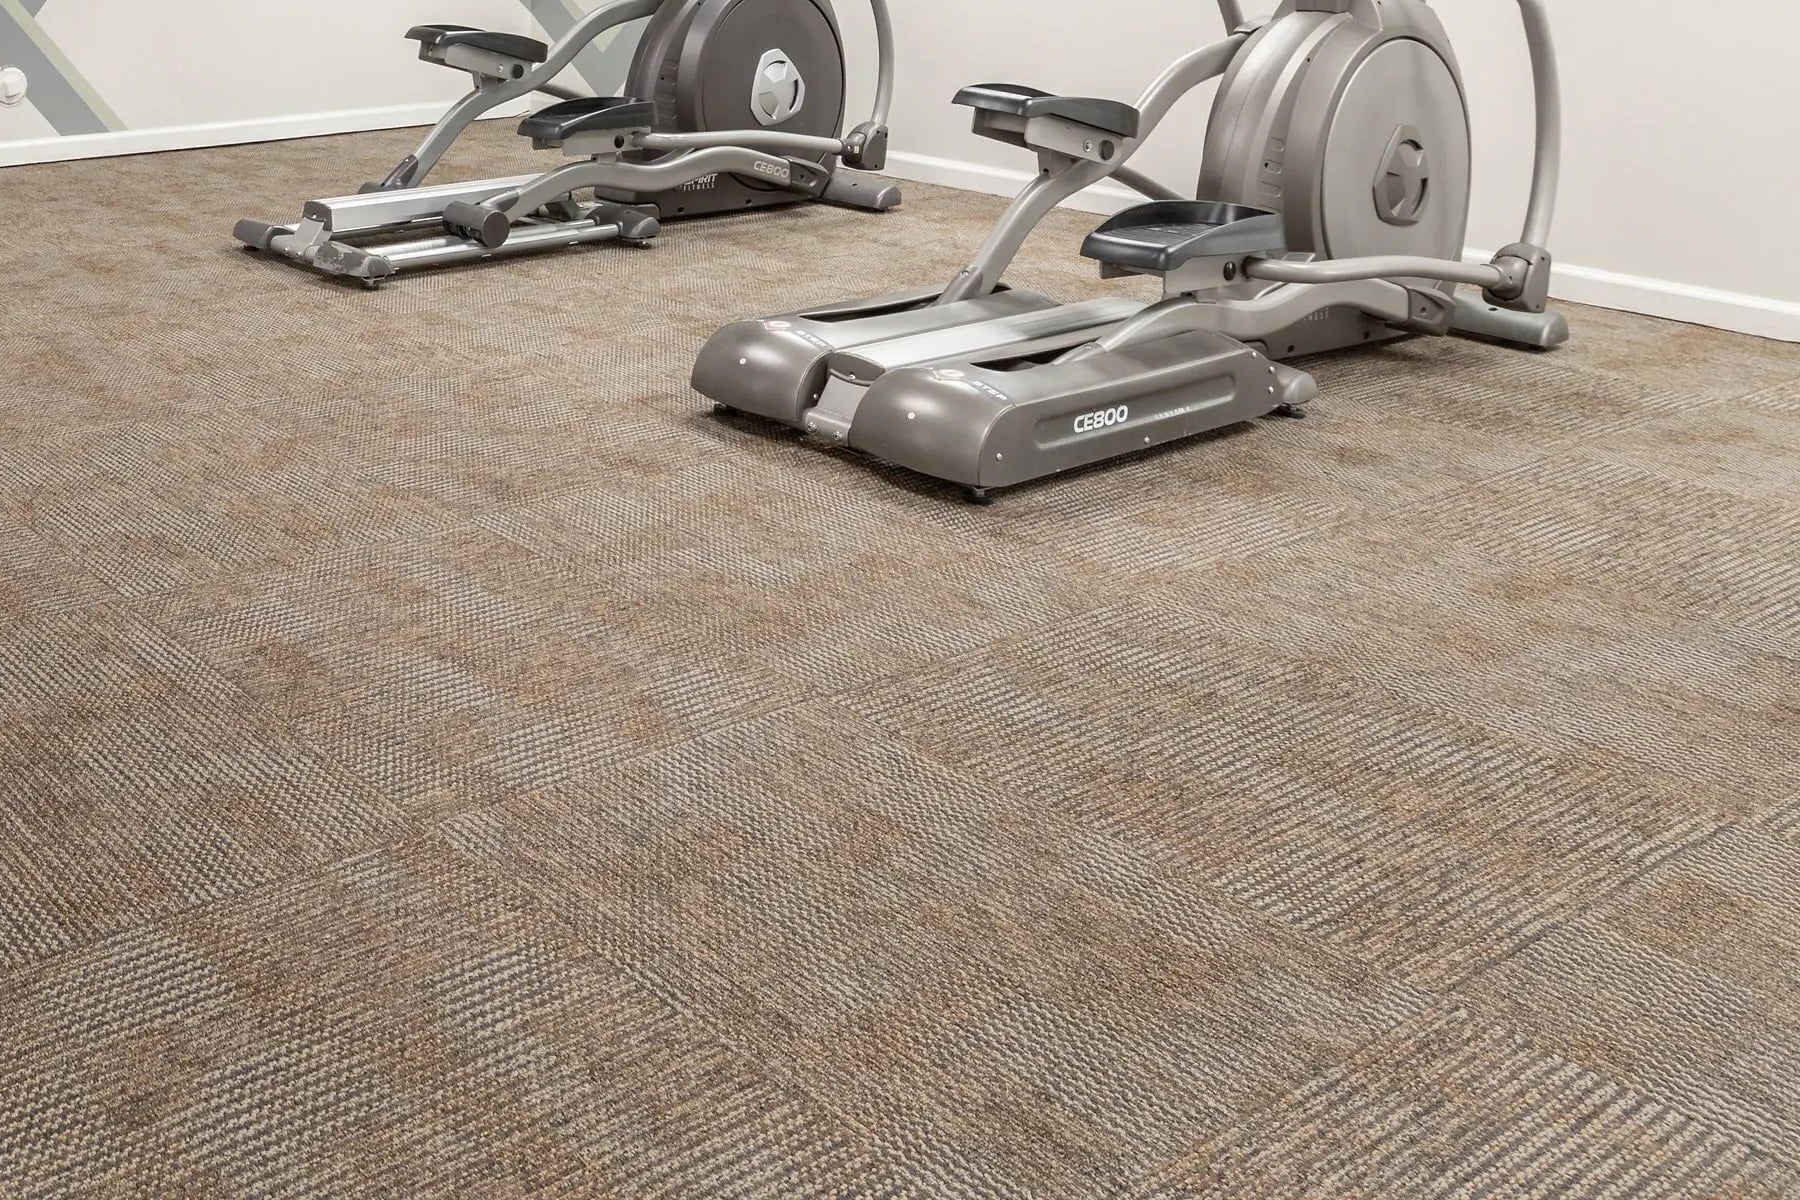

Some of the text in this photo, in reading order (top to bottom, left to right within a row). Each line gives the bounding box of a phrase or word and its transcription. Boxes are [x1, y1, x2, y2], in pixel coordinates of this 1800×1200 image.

[753, 160, 790, 178] CE800
[684, 173, 719, 185] IRIT
[1073, 405, 1129, 433] CE800
